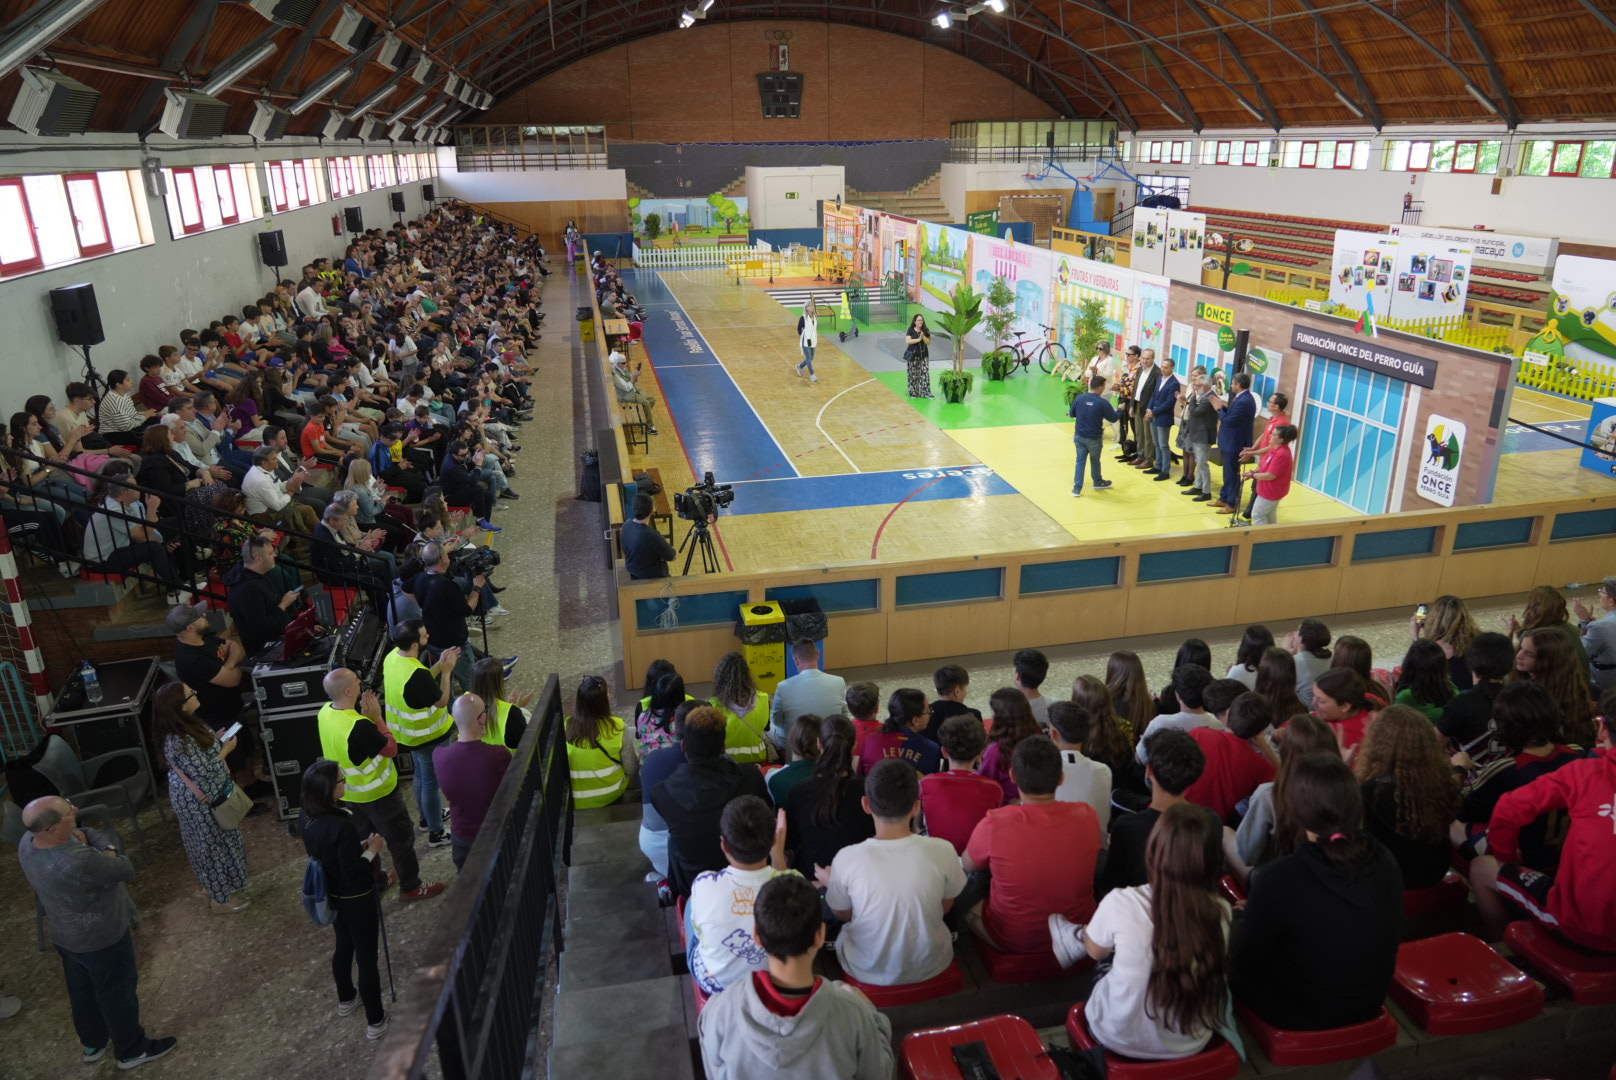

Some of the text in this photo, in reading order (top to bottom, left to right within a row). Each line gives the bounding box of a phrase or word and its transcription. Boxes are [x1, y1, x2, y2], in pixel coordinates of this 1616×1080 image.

[1481, 239, 1506, 247] municipal
[1475, 246, 1506, 258] macayo
[1071, 268, 1088, 283] FRUTAS
[1093, 274, 1120, 291] VERDURAS
[1205, 307, 1231, 323] ONCE
[1296, 332, 1425, 376] FUNDACIÓN ONCE DEL PERRO GUÍA
[1423, 466, 1453, 483] Fundación
[1420, 484, 1450, 500] PERRO GUÍA
[1421, 475, 1451, 494] ONCE
[882, 747, 922, 763] LEVRE
